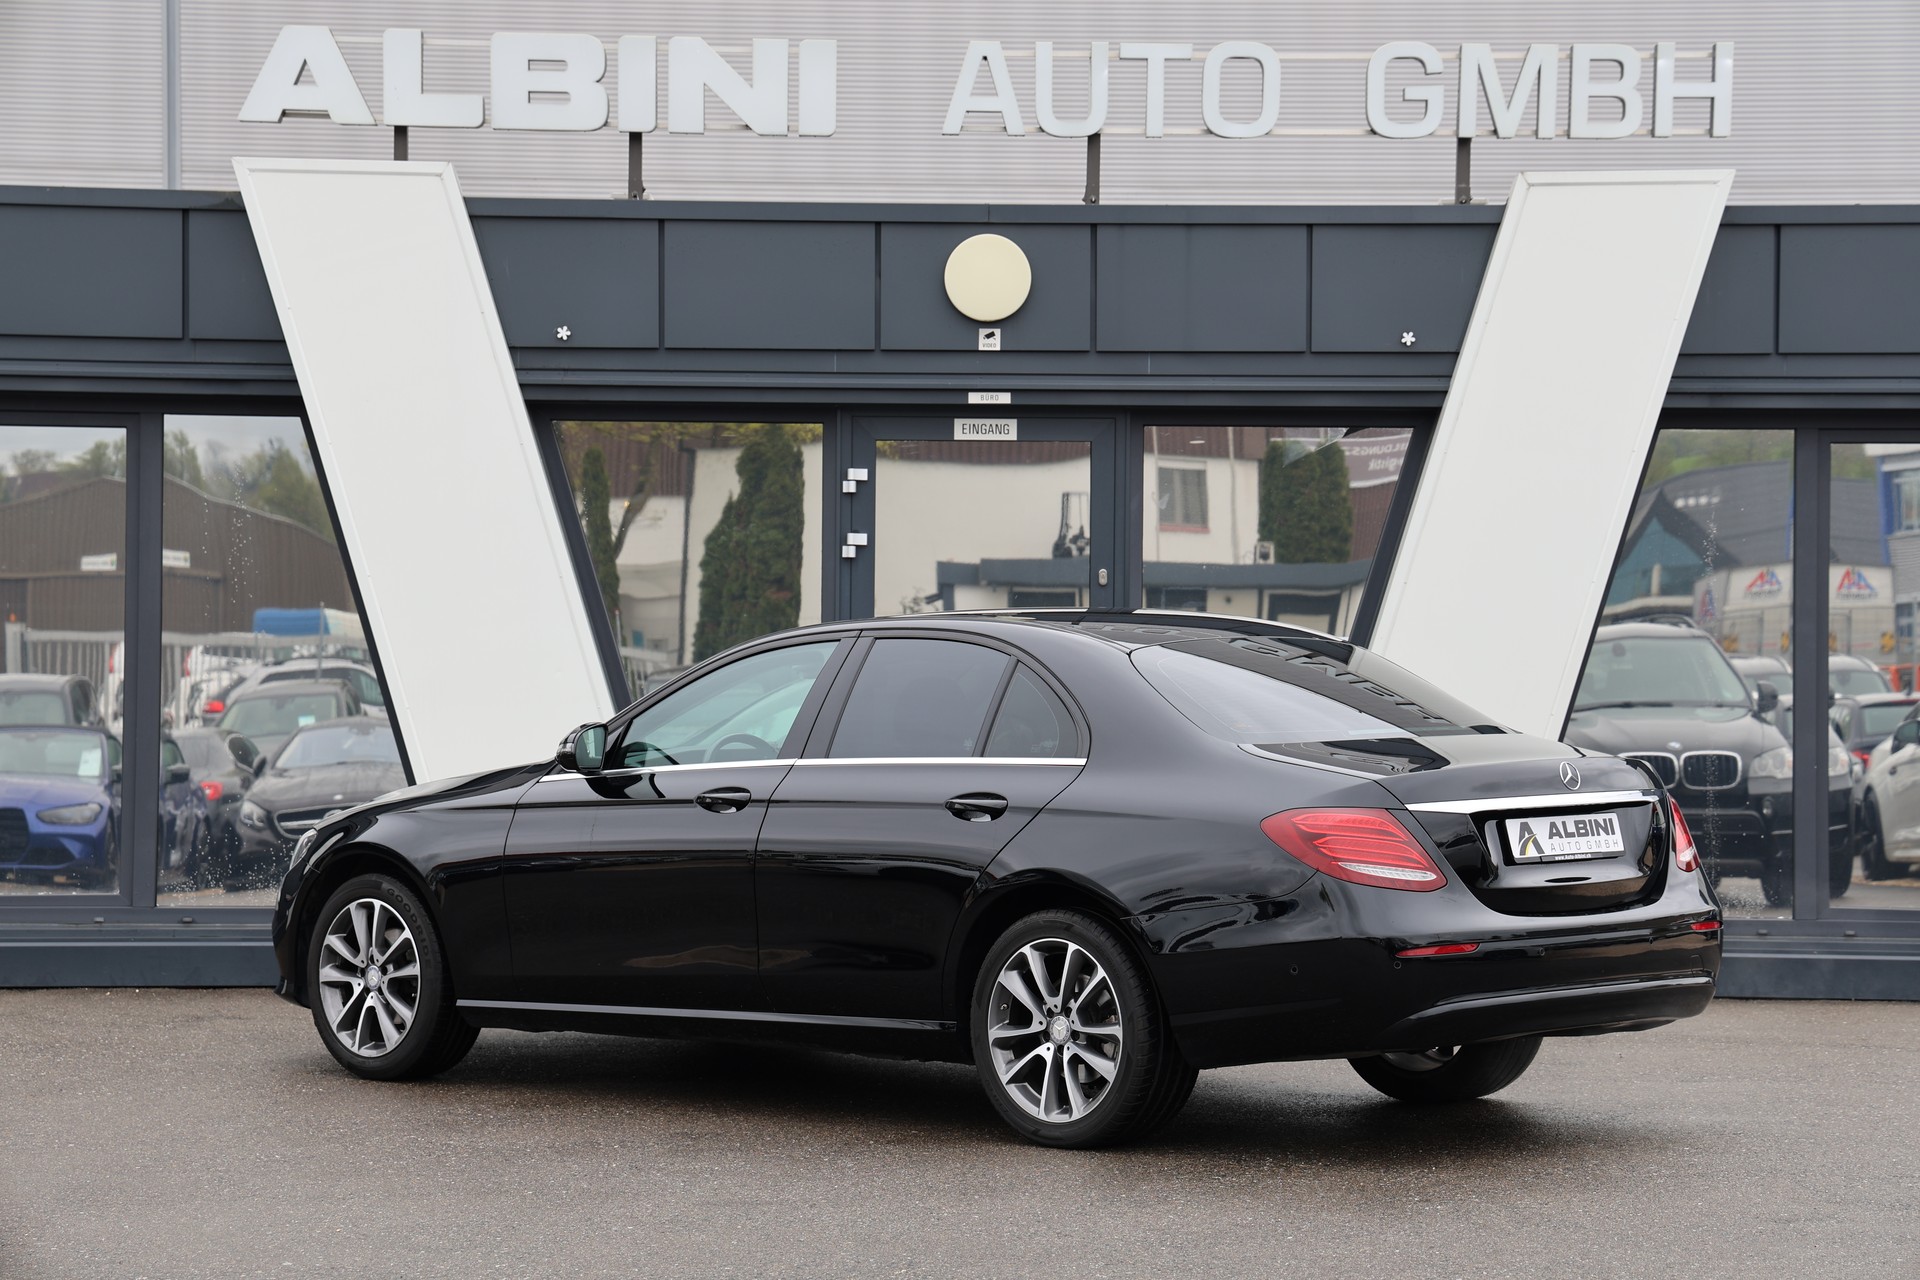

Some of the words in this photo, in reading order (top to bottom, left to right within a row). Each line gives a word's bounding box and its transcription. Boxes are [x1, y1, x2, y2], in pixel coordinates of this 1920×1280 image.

[237, 24, 837, 137] ALBINI
[942, 40, 1281, 138] AUTO
[1366, 40, 1735, 139] GMBH
[961, 423, 1010, 435] EINGANG
[1548, 818, 1615, 839] ALBINI
[1550, 841, 1581, 852] AUTO
[1586, 839, 1619, 850] GMBH
